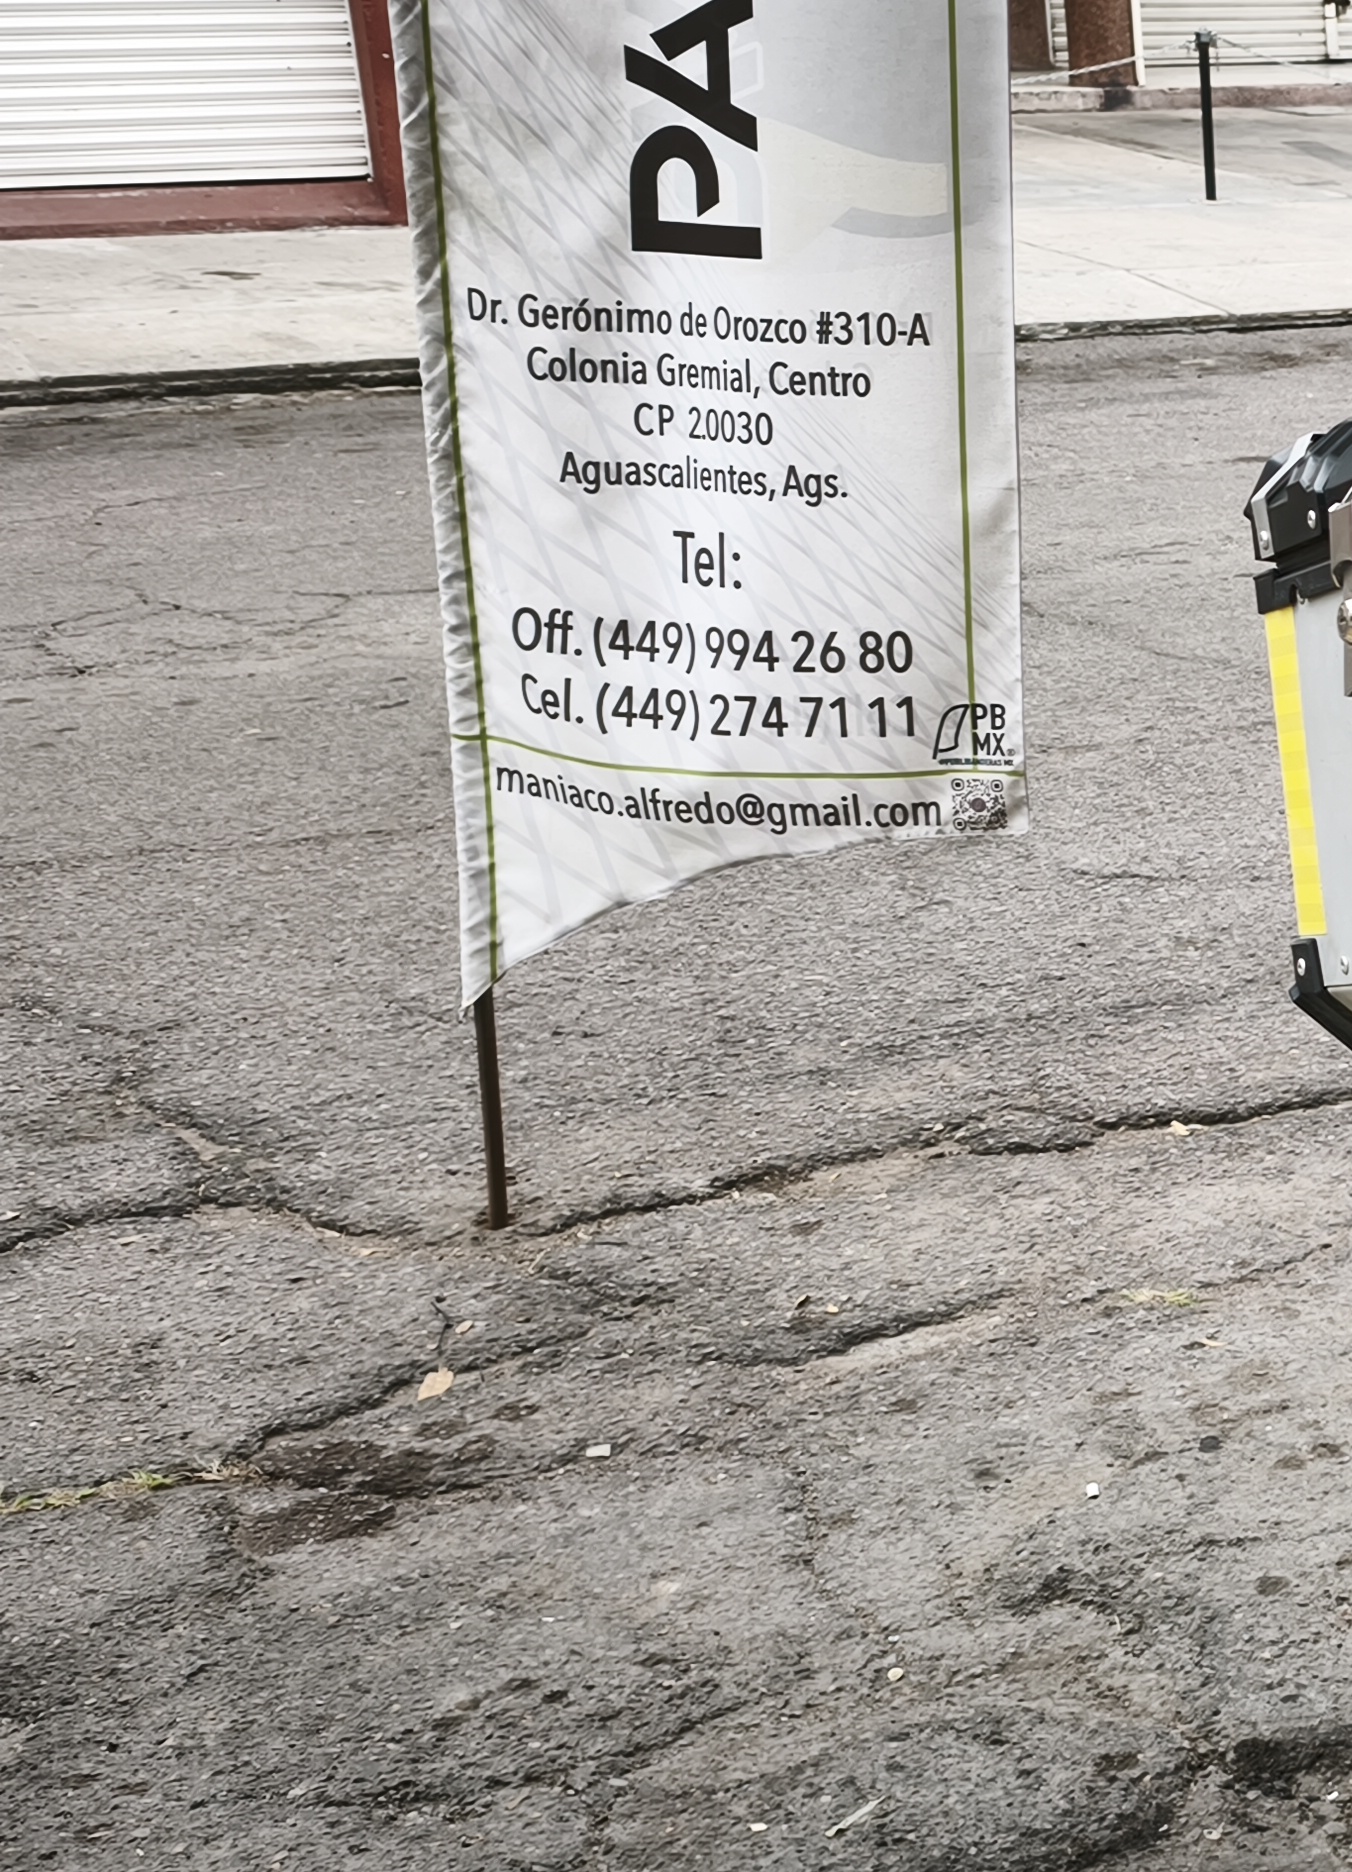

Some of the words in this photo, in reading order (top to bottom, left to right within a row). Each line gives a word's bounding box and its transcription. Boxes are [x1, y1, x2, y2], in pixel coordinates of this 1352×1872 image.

[467, 287, 508, 325] Dr.
[517, 293, 672, 335] Gerónimo
[680, 301, 707, 338] de
[713, 306, 807, 345] Orozco
[815, 311, 931, 347] #310-A
[526, 346, 647, 385] Colonia
[656, 353, 761, 399] Gremial,
[768, 361, 871, 398] Centro
[633, 402, 674, 437] CP
[559, 451, 776, 502] Aguascalientes,
[782, 464, 848, 508] Ags.
[672, 530, 742, 590] Tel:
[512, 606, 583, 657] Off.
[593, 616, 696, 675] (449)
[705, 626, 780, 673] 994
[790, 630, 846, 674] 26
[859, 630, 913, 674] 80
[521, 673, 584, 724] Cel.
[596, 682, 700, 742] (449)
[709, 693, 789, 738] 274
[800, 696, 848, 738] 71
[867, 695, 915, 738] 11
[972, 703, 1006, 731] PB
[496, 766, 942, 835] maniaco.alfredo@gmail.com
